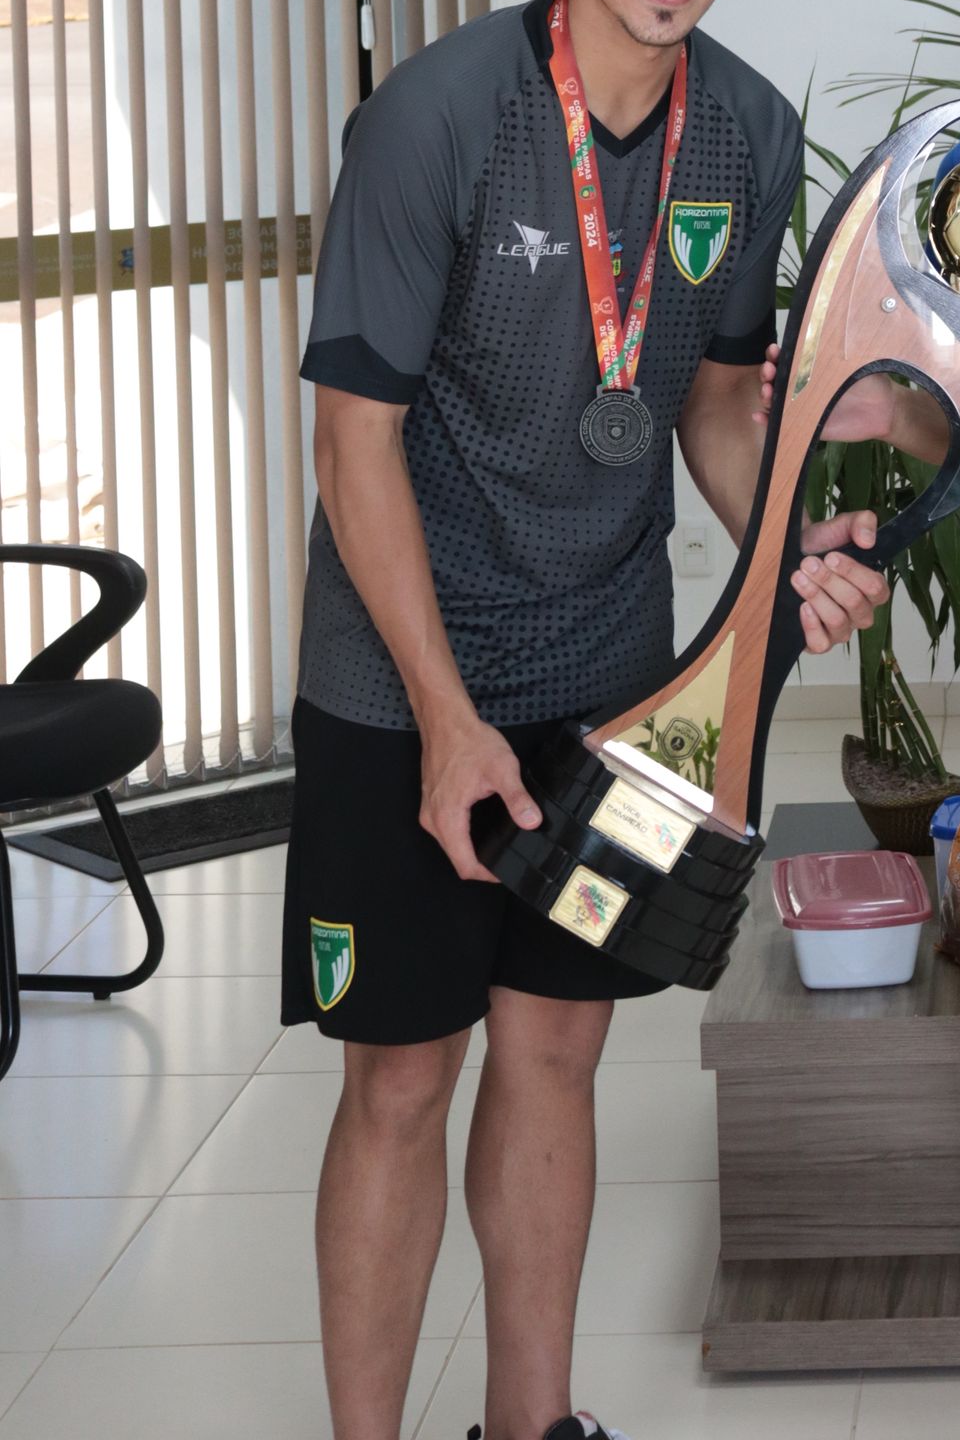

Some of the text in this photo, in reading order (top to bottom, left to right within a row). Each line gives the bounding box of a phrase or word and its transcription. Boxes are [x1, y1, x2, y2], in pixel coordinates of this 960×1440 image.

[571, 120, 583, 154] FUTSAL
[576, 156, 585, 177] 2024
[582, 145, 592, 180] PAMPAS
[583, 213, 598, 248] 2024
[497, 242, 571, 257] LEAGUE
